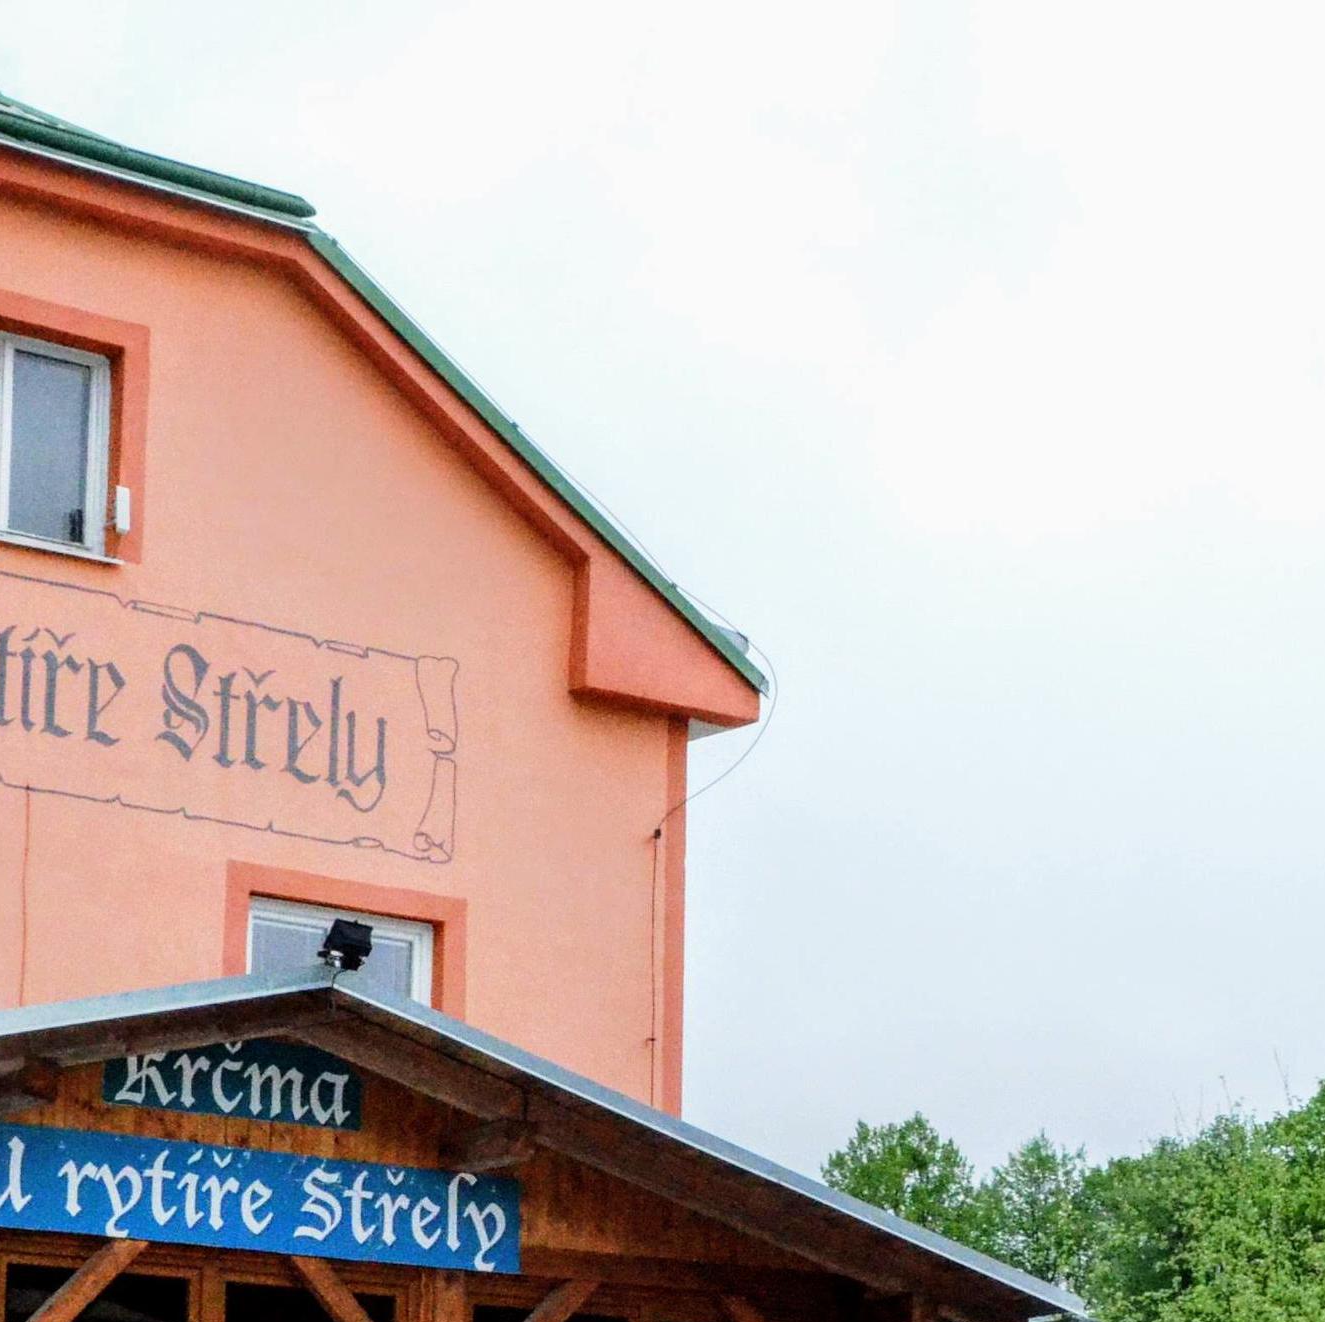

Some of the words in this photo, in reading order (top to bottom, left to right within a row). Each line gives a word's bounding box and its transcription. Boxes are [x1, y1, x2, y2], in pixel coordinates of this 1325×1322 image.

[154, 642, 386, 812] Střely
[113, 1041, 351, 1127] Krčma
[58, 1149, 273, 1238] rytíře
[292, 1164, 507, 1272] Střely
